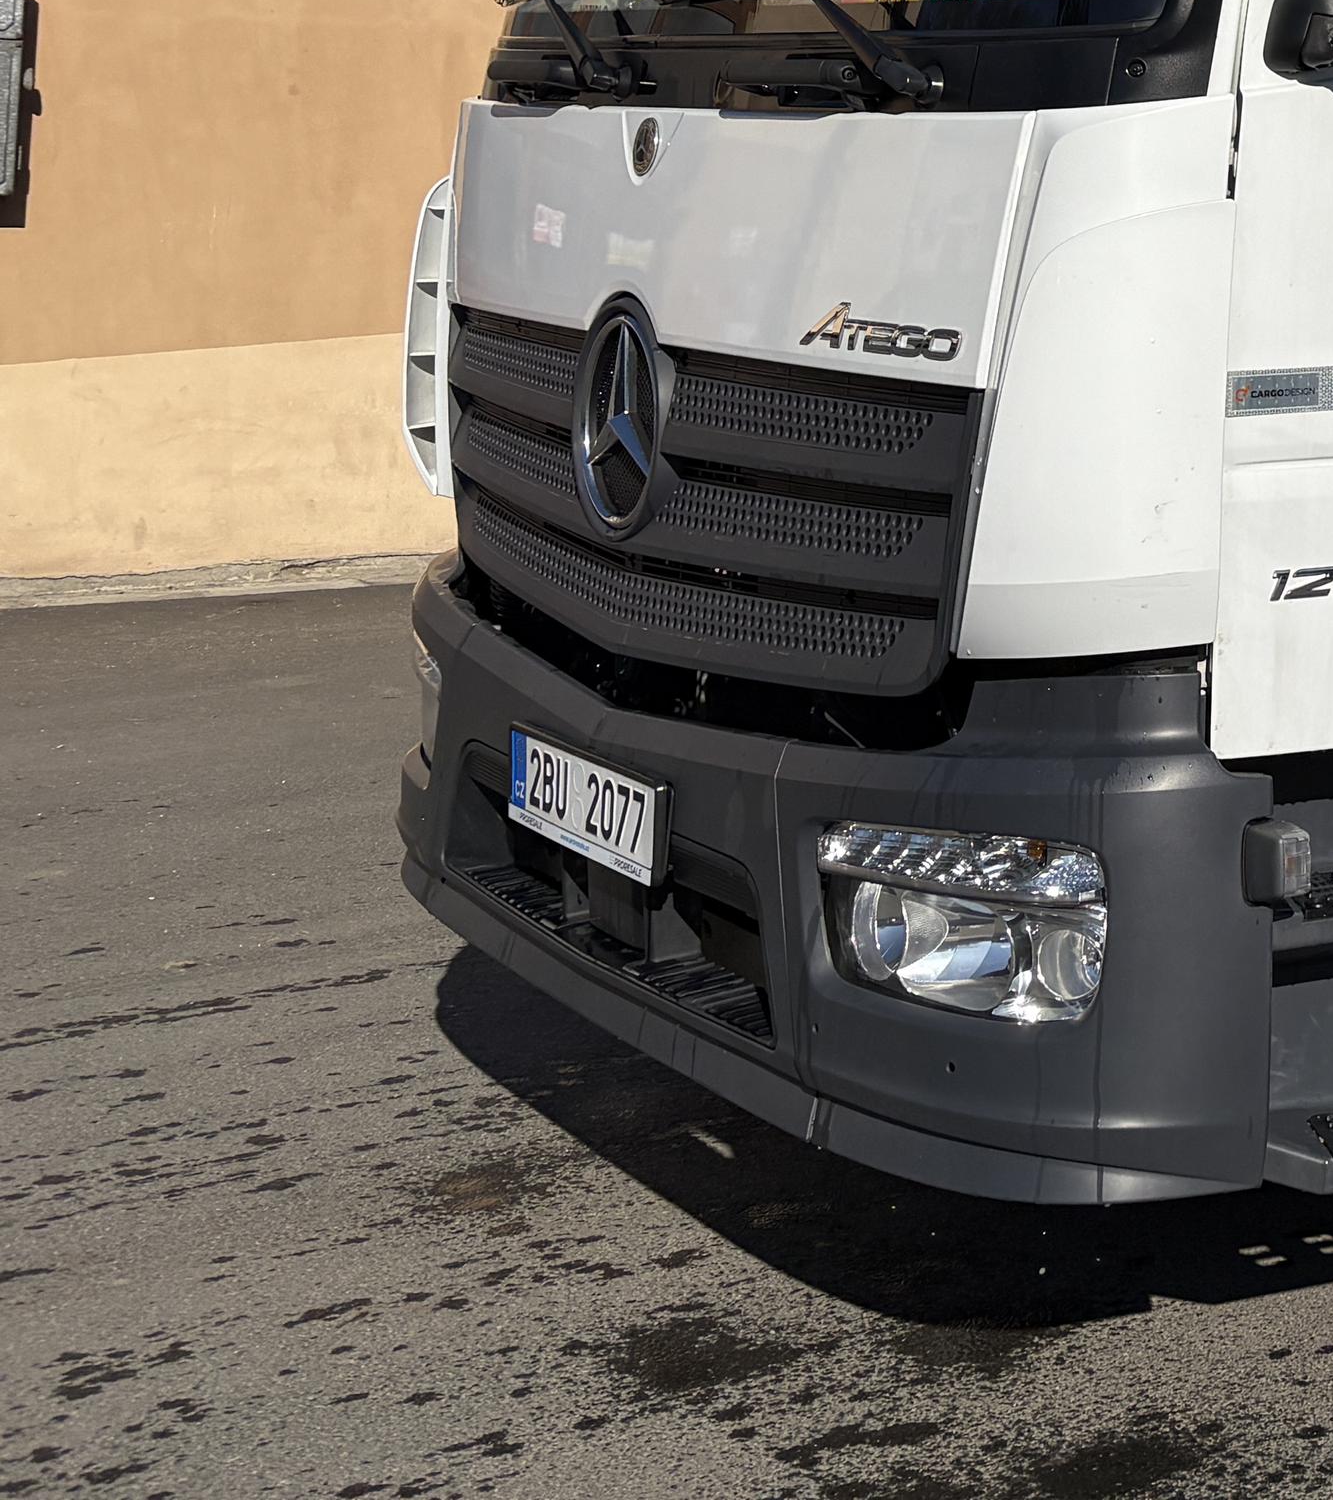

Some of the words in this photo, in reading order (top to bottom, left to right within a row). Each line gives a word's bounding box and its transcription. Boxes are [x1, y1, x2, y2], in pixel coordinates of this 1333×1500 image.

[515, 779, 525, 799] CZ
[529, 747, 569, 821] 2BU
[585, 772, 646, 854] 2077
